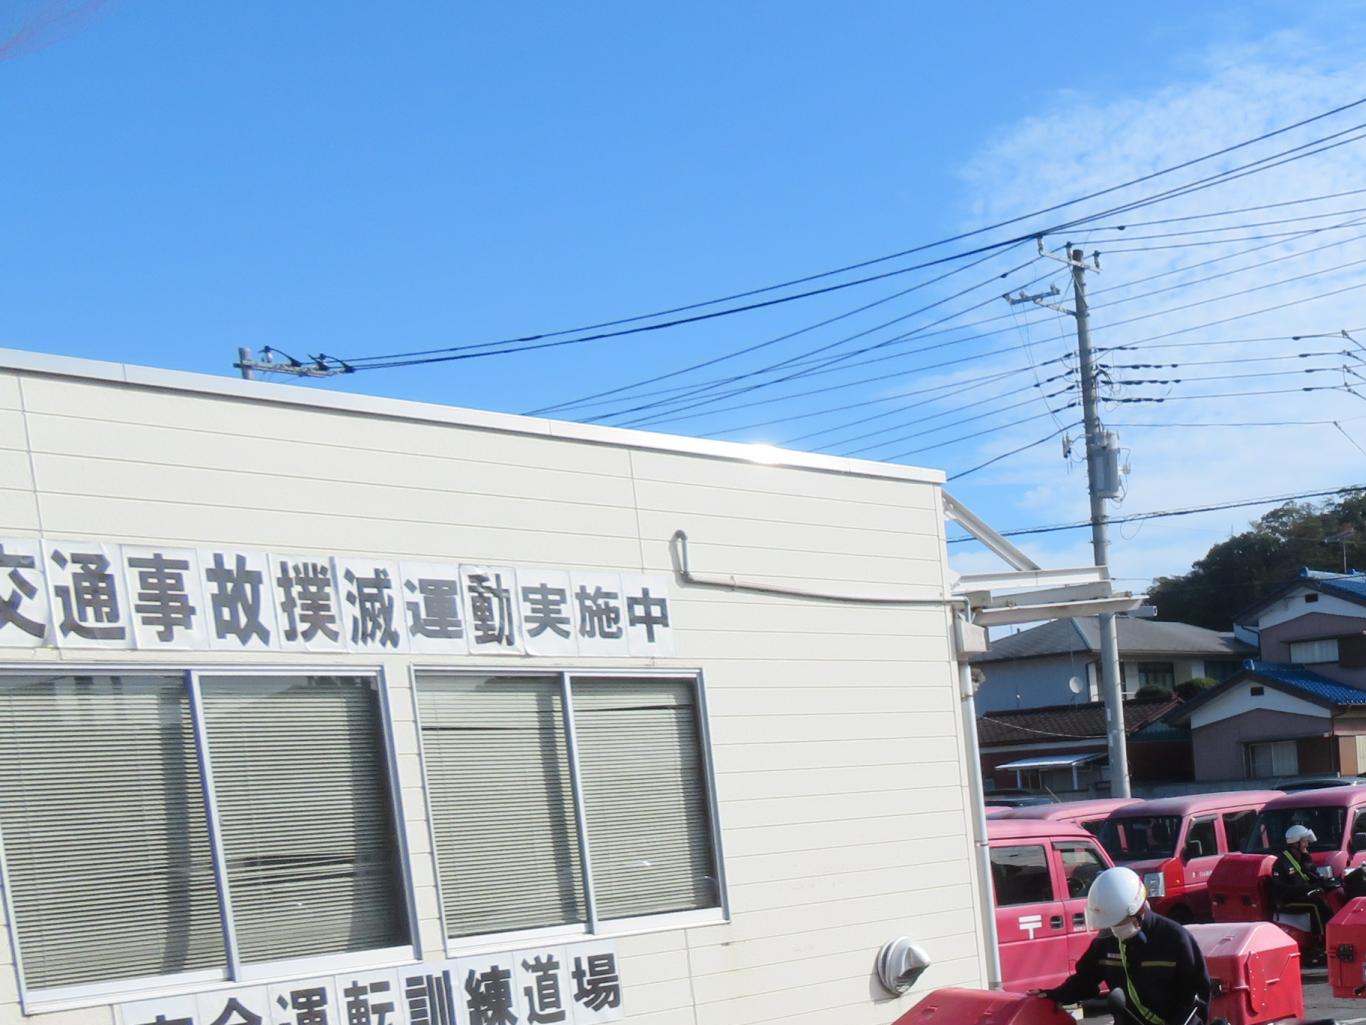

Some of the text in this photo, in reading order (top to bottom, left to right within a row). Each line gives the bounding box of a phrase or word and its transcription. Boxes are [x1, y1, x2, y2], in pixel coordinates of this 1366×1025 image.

[0, 544, 670, 648] 交通事故撲滅運動実施中
